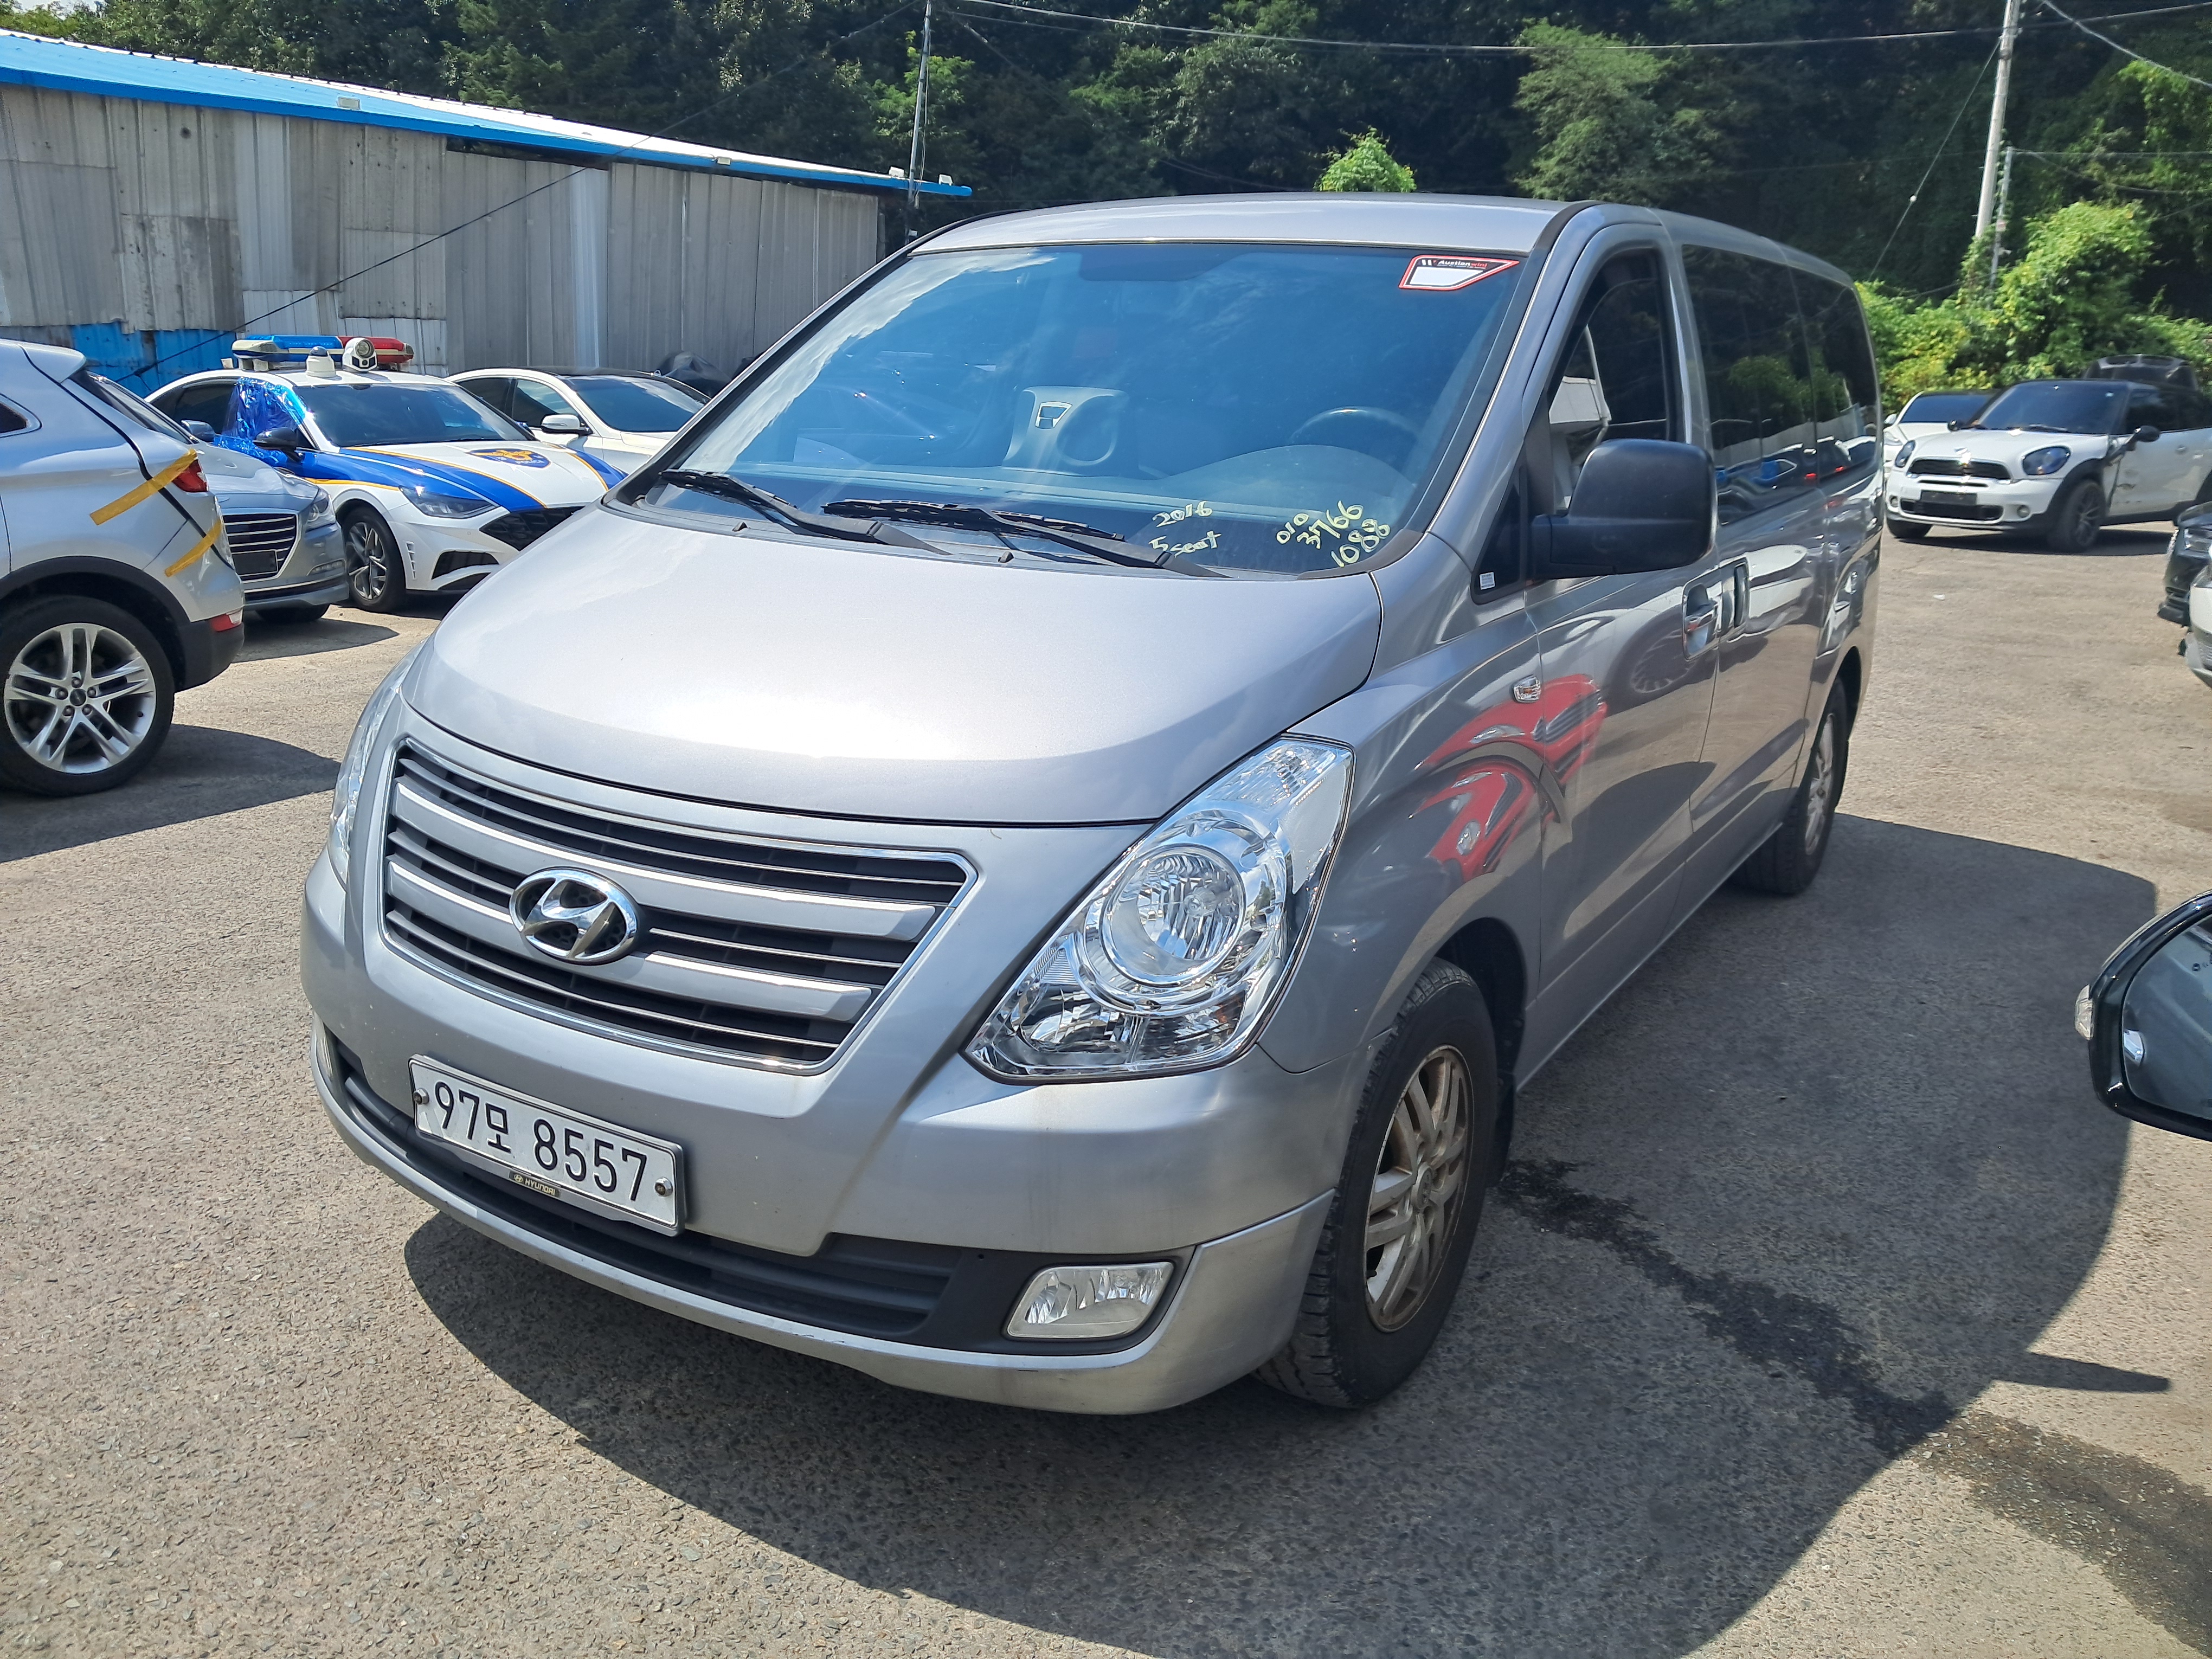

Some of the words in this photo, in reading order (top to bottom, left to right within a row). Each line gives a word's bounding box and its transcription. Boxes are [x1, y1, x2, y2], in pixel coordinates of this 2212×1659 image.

[1152, 500, 1213, 528] 2016
[1276, 512, 1310, 544] 010
[1296, 499, 1365, 550] 3766
[1169, 530, 1222, 558] seat
[1330, 518, 1391, 568] 1088
[434, 1081, 511, 1153] 97모
[533, 1119, 647, 1201] 8557
[525, 1178, 556, 1195] HYUNDAI
